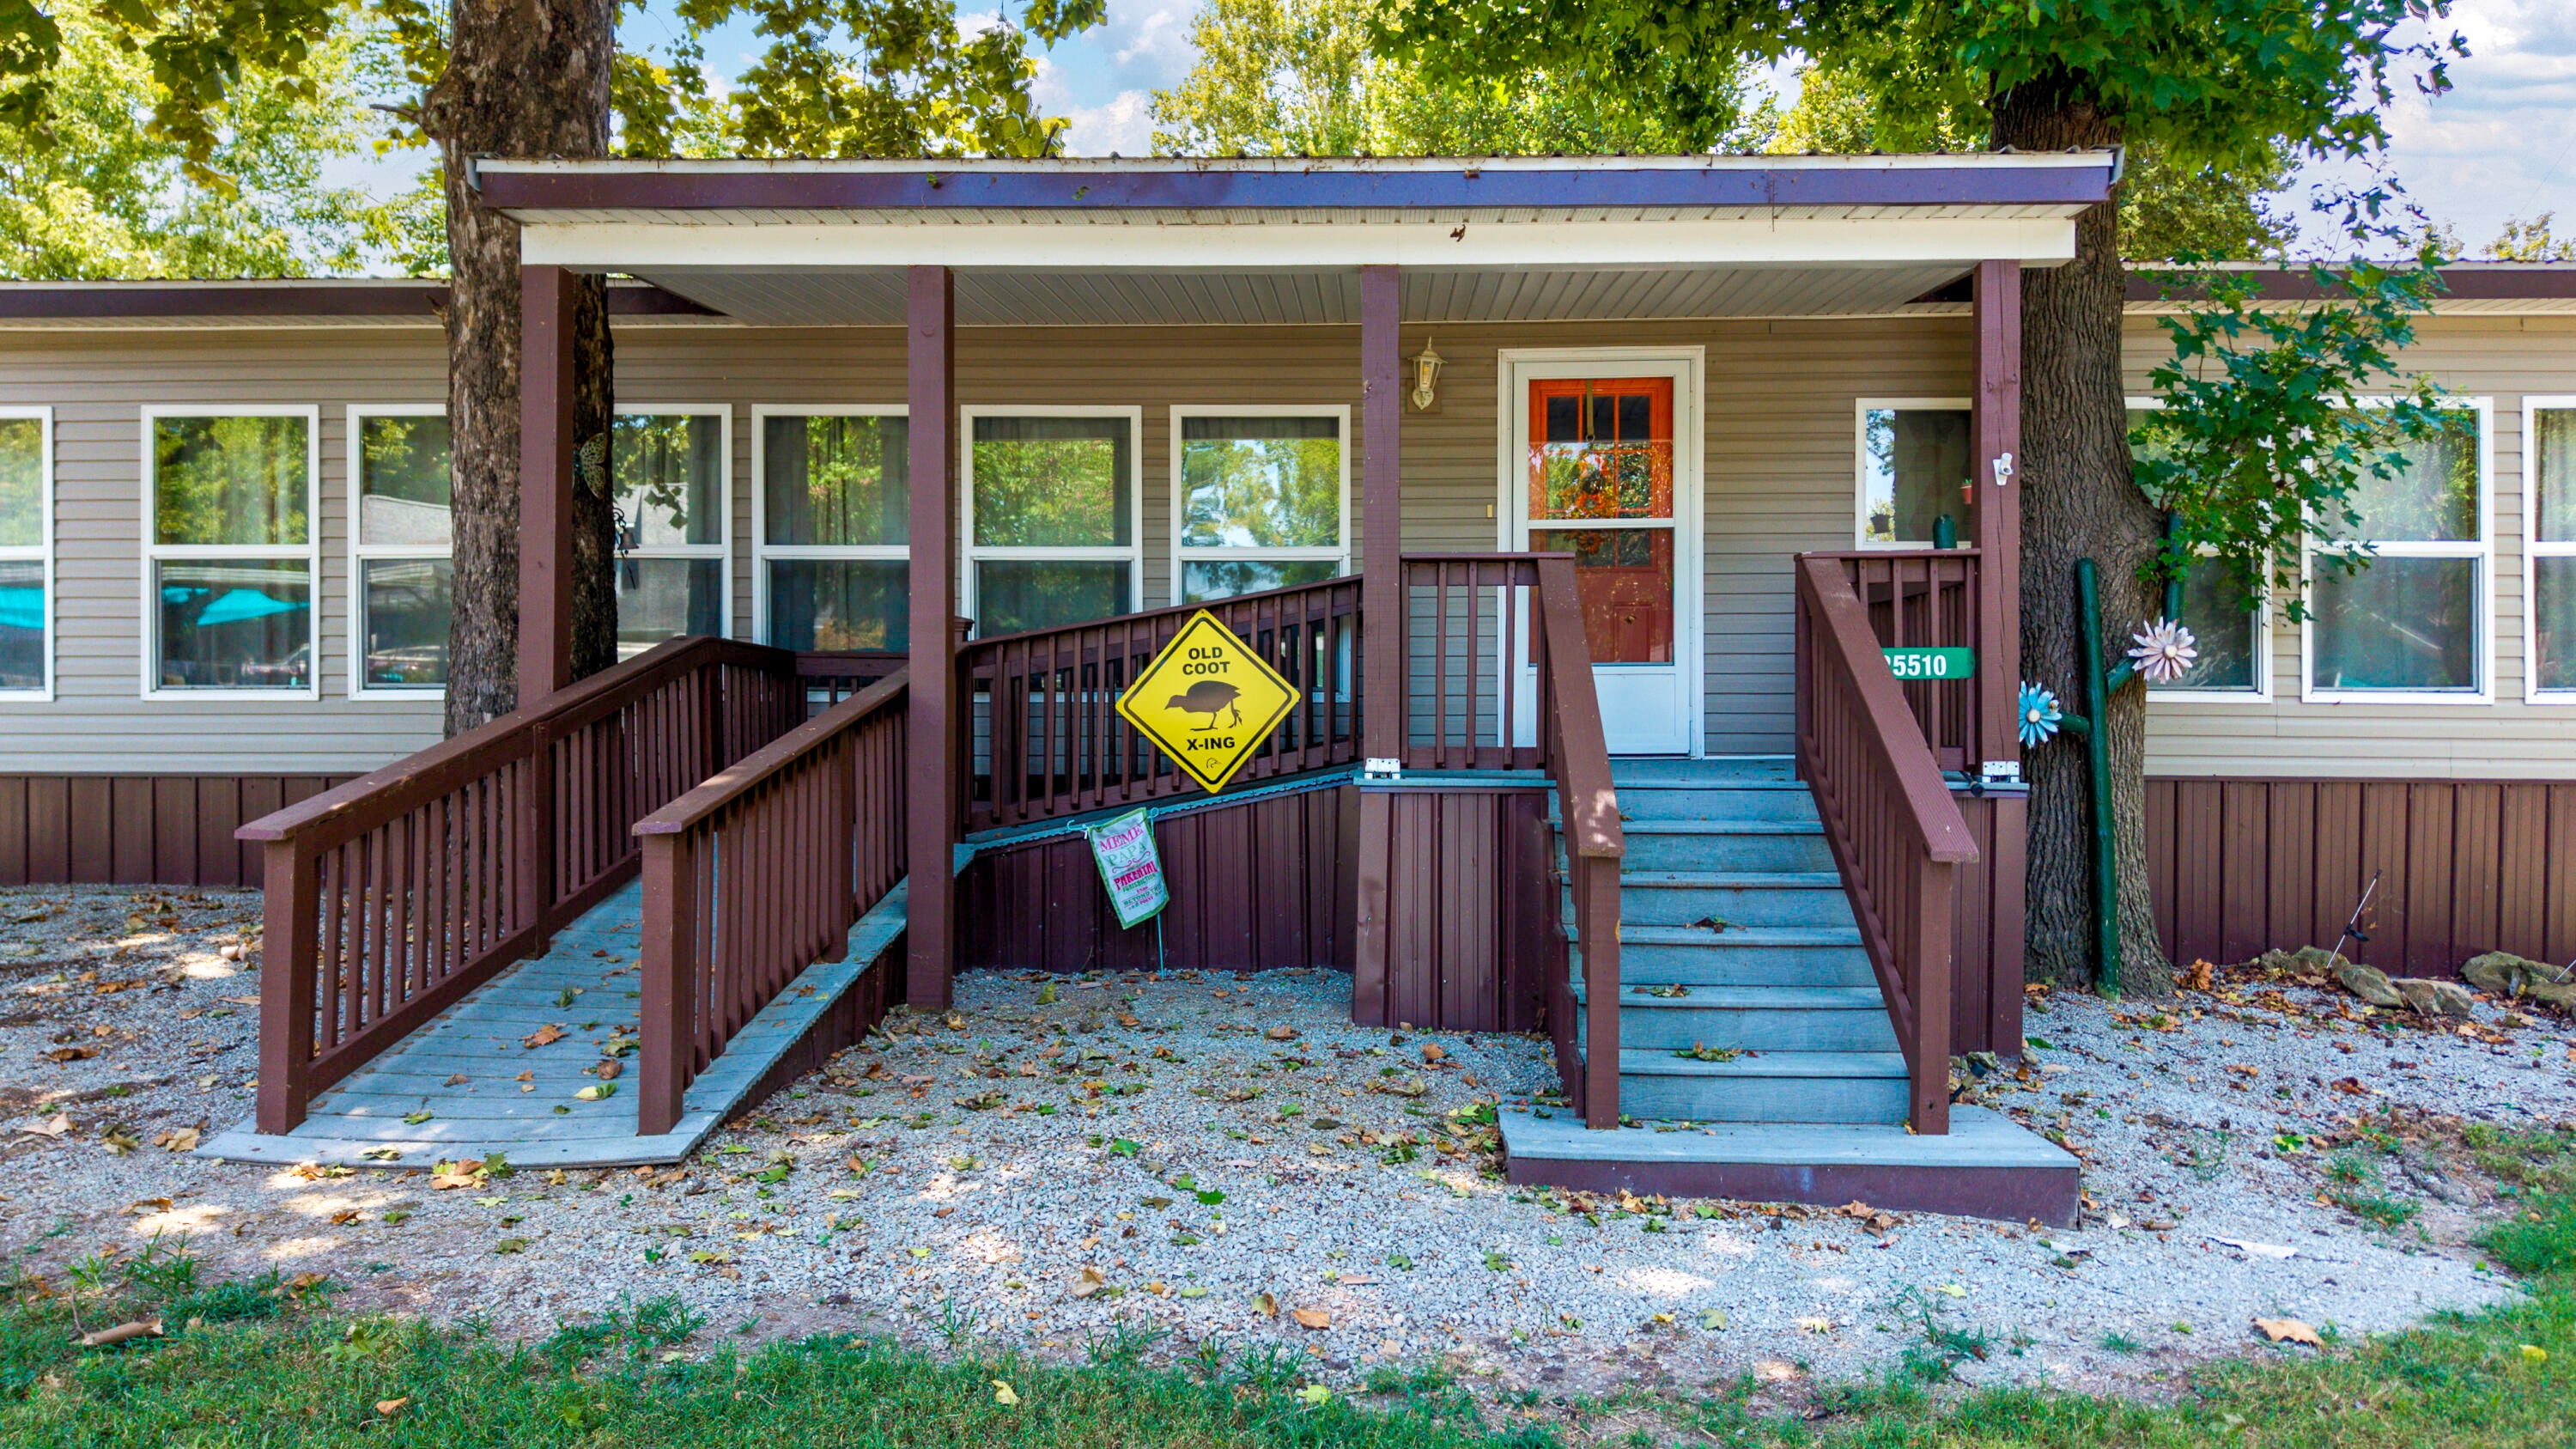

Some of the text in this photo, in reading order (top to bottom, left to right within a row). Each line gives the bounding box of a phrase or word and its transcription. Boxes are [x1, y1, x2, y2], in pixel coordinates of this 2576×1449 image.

[1188, 647, 1223, 661] OLD
[1182, 661, 1230, 675] COOT
[1187, 736, 1235, 751] X-ING
[1099, 824, 1143, 852] MEME
[1107, 842, 1146, 866] PAPA
[1114, 861, 1157, 891] PARENTAL
